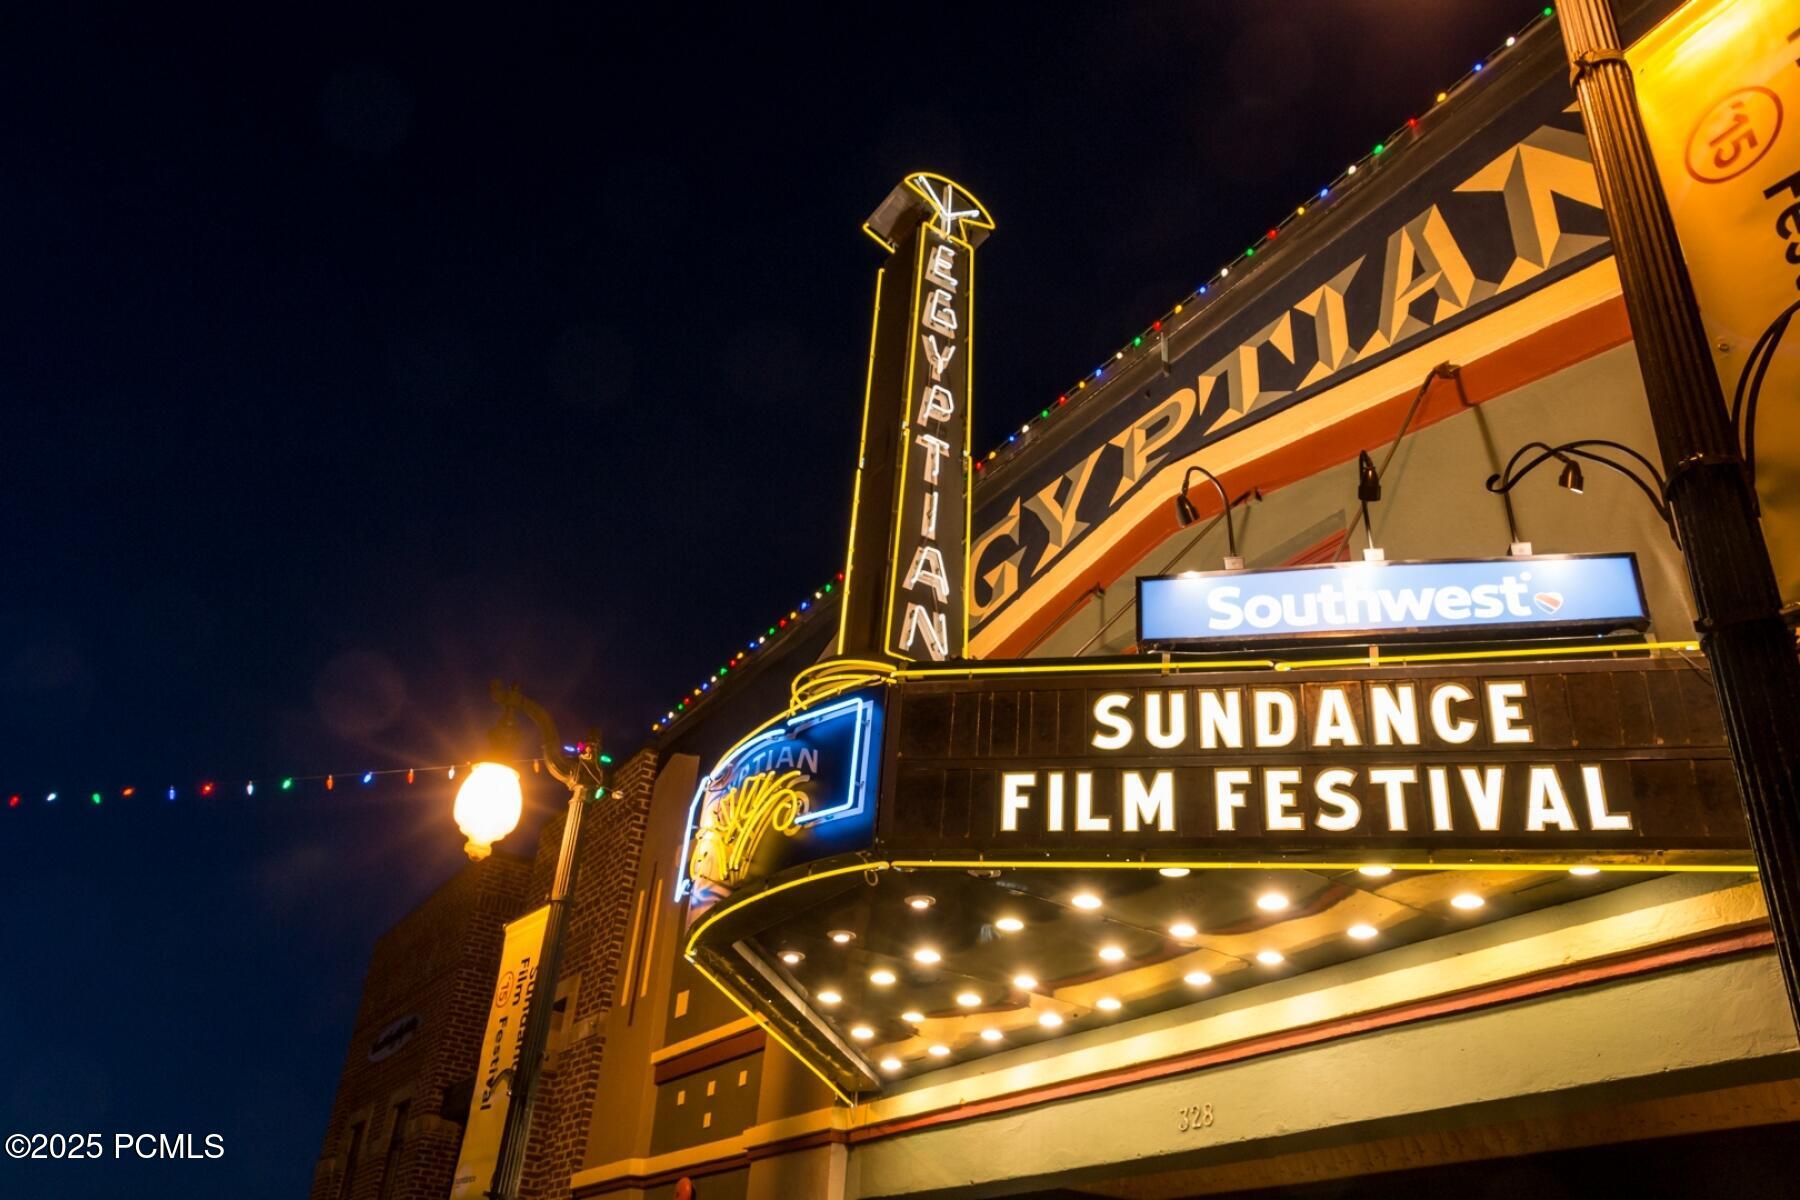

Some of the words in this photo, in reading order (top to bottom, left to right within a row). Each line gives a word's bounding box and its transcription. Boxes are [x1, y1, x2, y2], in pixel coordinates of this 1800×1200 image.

[967, 100, 1612, 626] GYPTIAN
[900, 243, 959, 662] EGYPTIAN
[1207, 574, 1533, 631] Southwest
[1091, 680, 1535, 751] SUNDANCE
[1000, 771, 1176, 833] FILM
[1213, 763, 1634, 833] FESTIVAL
[512, 957, 530, 1006] Film
[1178, 1102, 1214, 1132] 328
